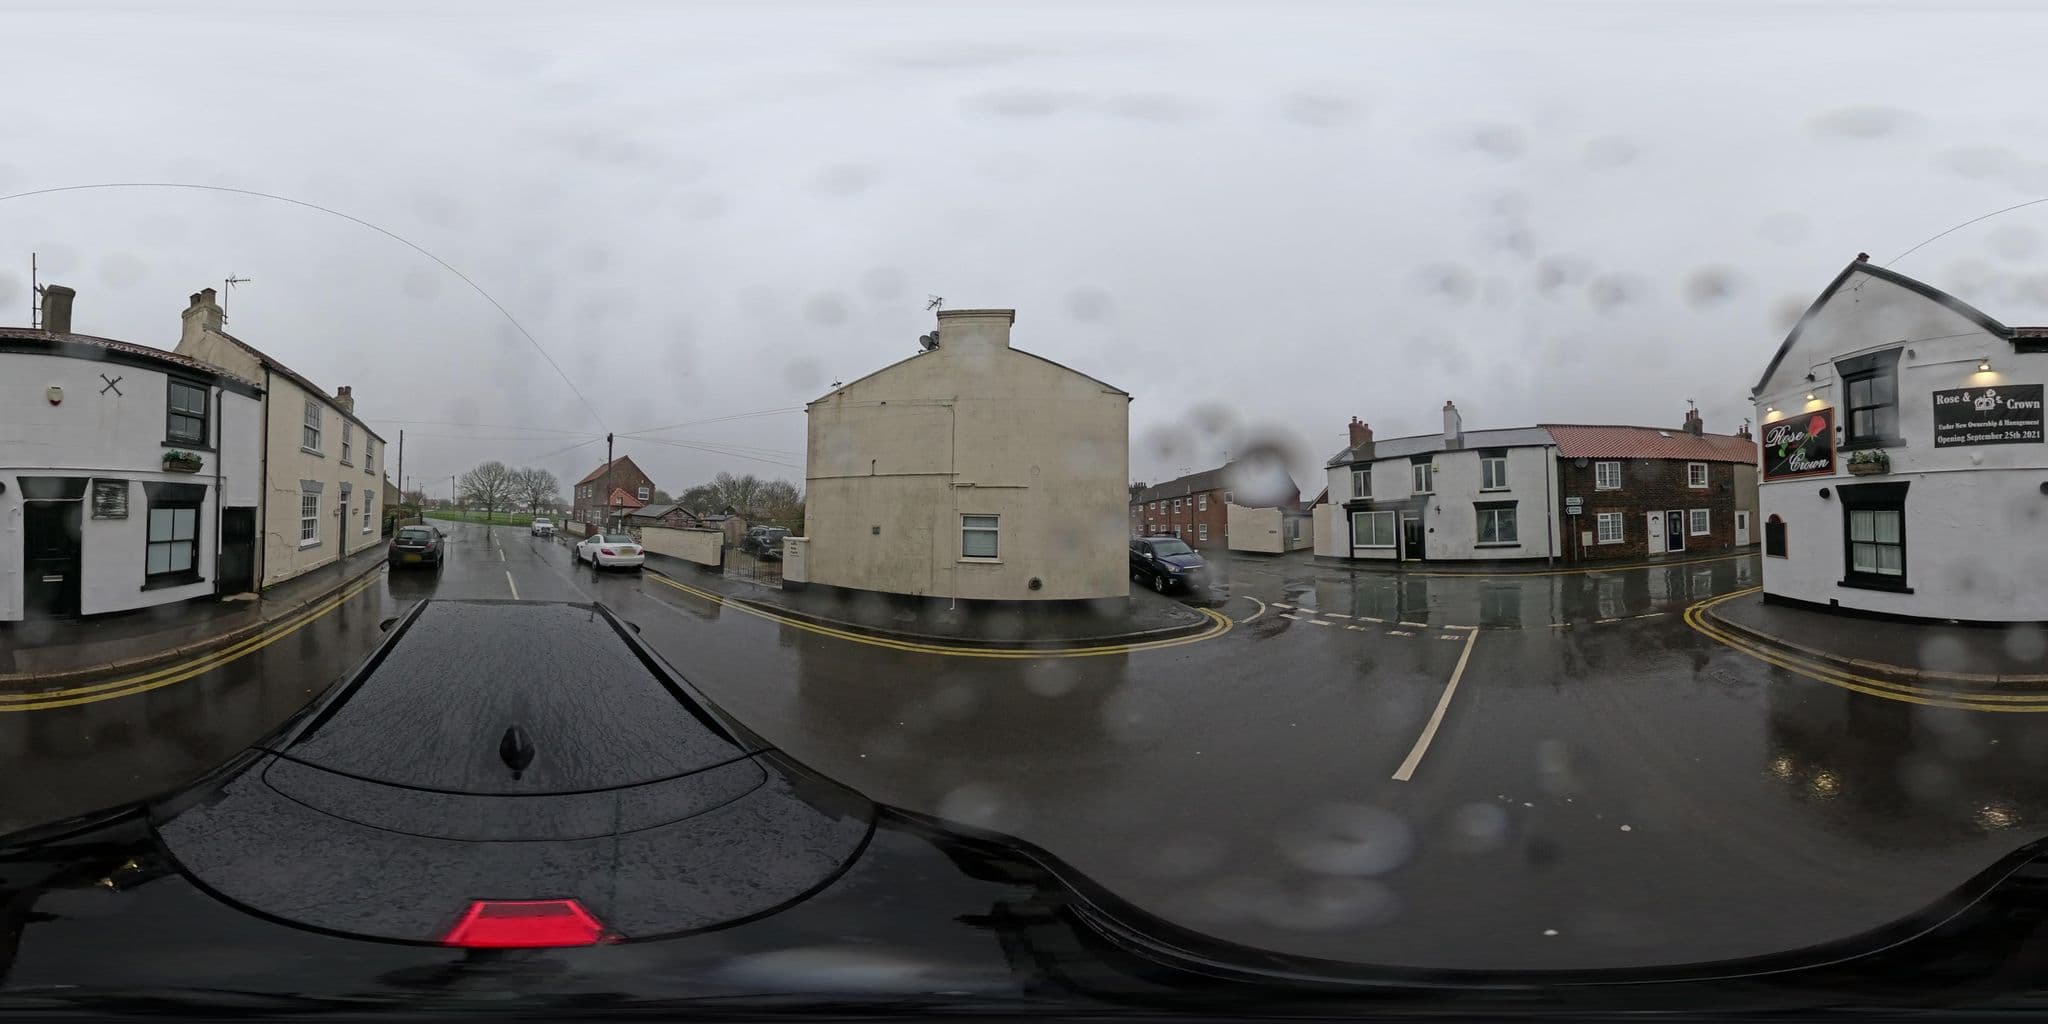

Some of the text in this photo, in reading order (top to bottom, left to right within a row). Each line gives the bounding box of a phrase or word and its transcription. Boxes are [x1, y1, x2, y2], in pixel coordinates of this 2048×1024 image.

[1936, 392, 2040, 409] Rose & Crown
[1765, 425, 1805, 448] Rose
[1938, 434, 1966, 444] Opening
[1966, 432, 2002, 441] September
[2022, 430, 2040, 439] 2021
[1790, 452, 1829, 471] Crown
